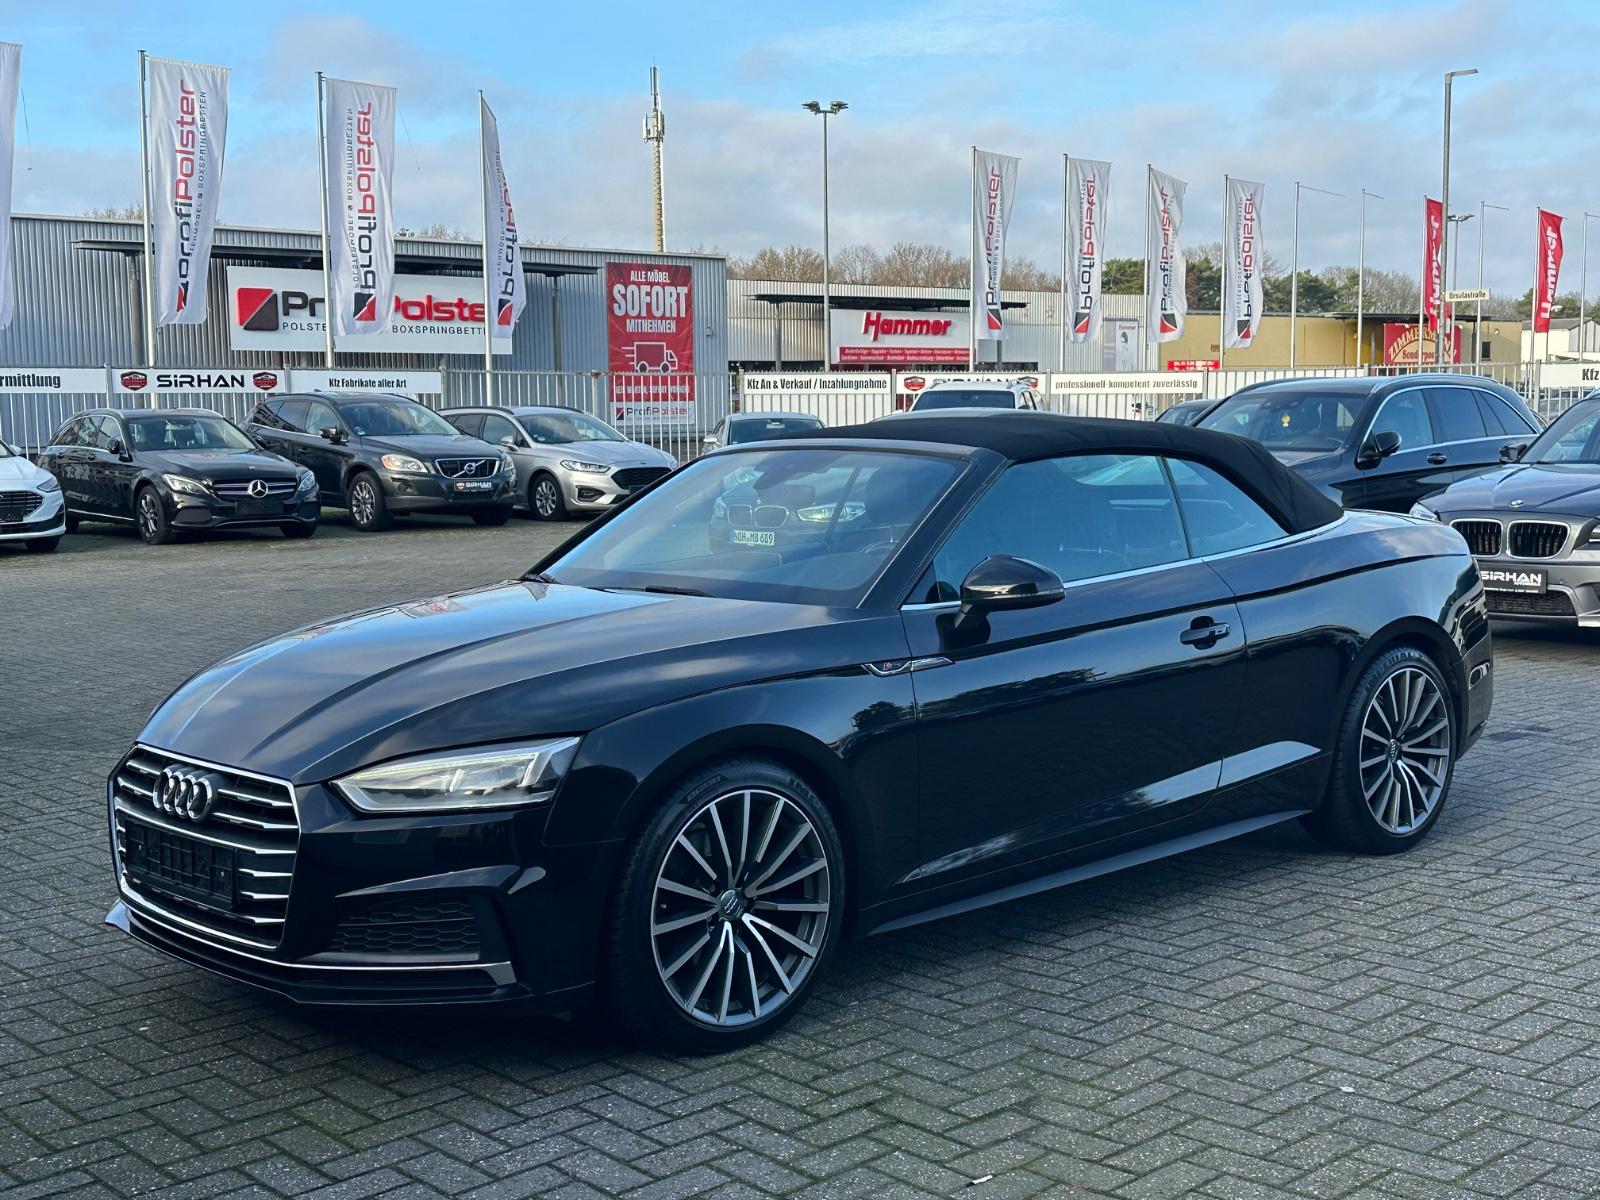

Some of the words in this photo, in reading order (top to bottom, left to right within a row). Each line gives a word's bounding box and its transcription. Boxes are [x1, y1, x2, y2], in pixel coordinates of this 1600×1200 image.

[630, 270, 646, 282] ALLE
[647, 269, 671, 283] MÖBEL
[612, 283, 688, 318] SOFORT
[626, 319, 676, 333] MITNEHMEN
[861, 312, 952, 342] Hammer
[1582, 368, 1600, 381] Kfz
[329, 378, 340, 388] Kfz
[341, 378, 376, 388] Fabrikate
[377, 378, 394, 388] aller
[395, 378, 407, 388] Art
[747, 378, 759, 390] Kfz
[760, 378, 771, 390] An
[772, 379, 779, 389] &
[780, 378, 812, 390] Verkauf
[819, 378, 887, 390] Inzahlungnahme
